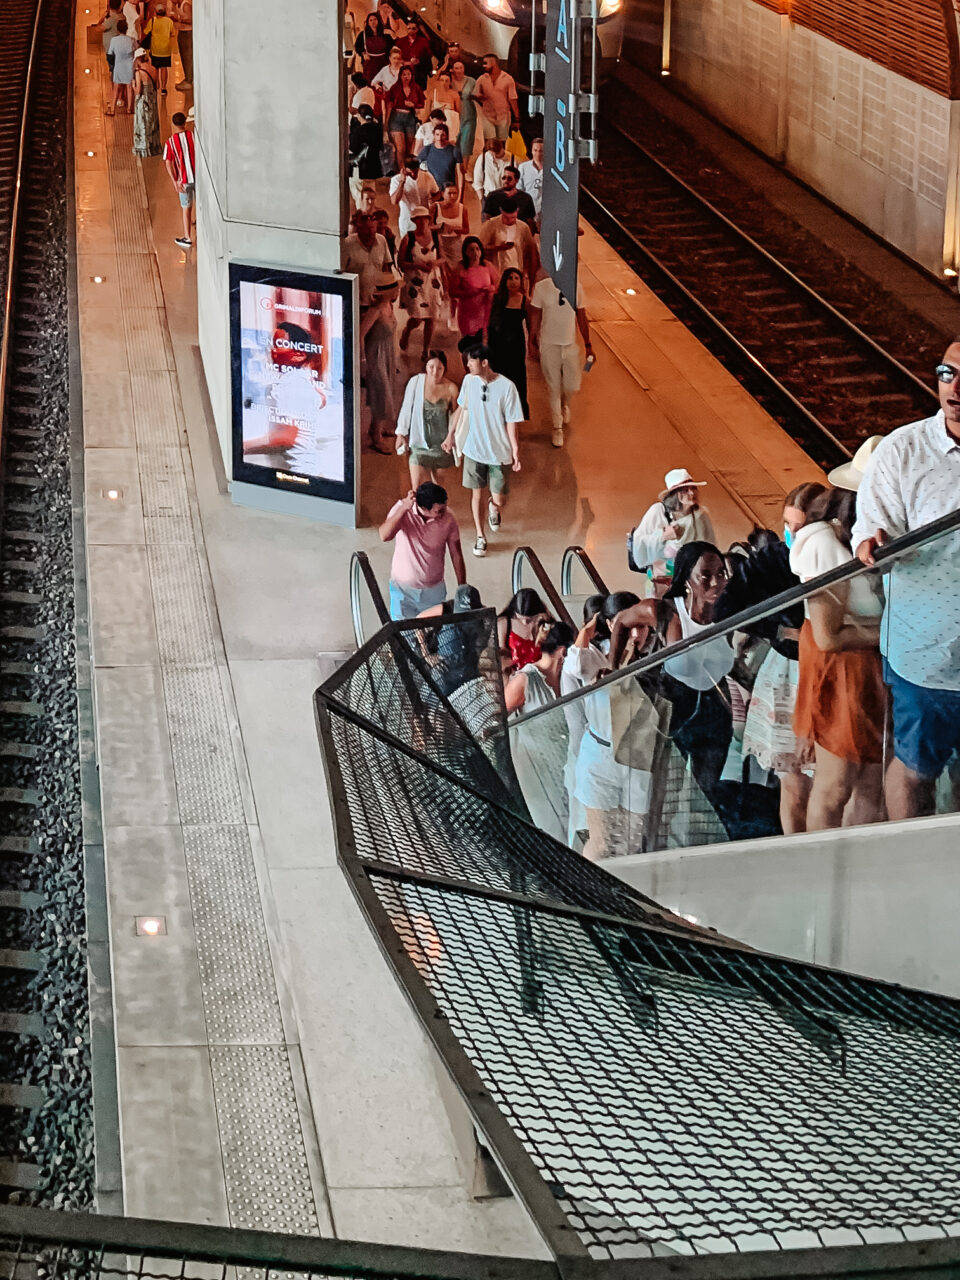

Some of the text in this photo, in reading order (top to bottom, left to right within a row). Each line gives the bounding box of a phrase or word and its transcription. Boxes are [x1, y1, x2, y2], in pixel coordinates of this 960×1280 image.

[555, 120, 566, 172] B
[260, 336, 324, 354] EN CONCERT
[266, 363, 280, 372] MC
